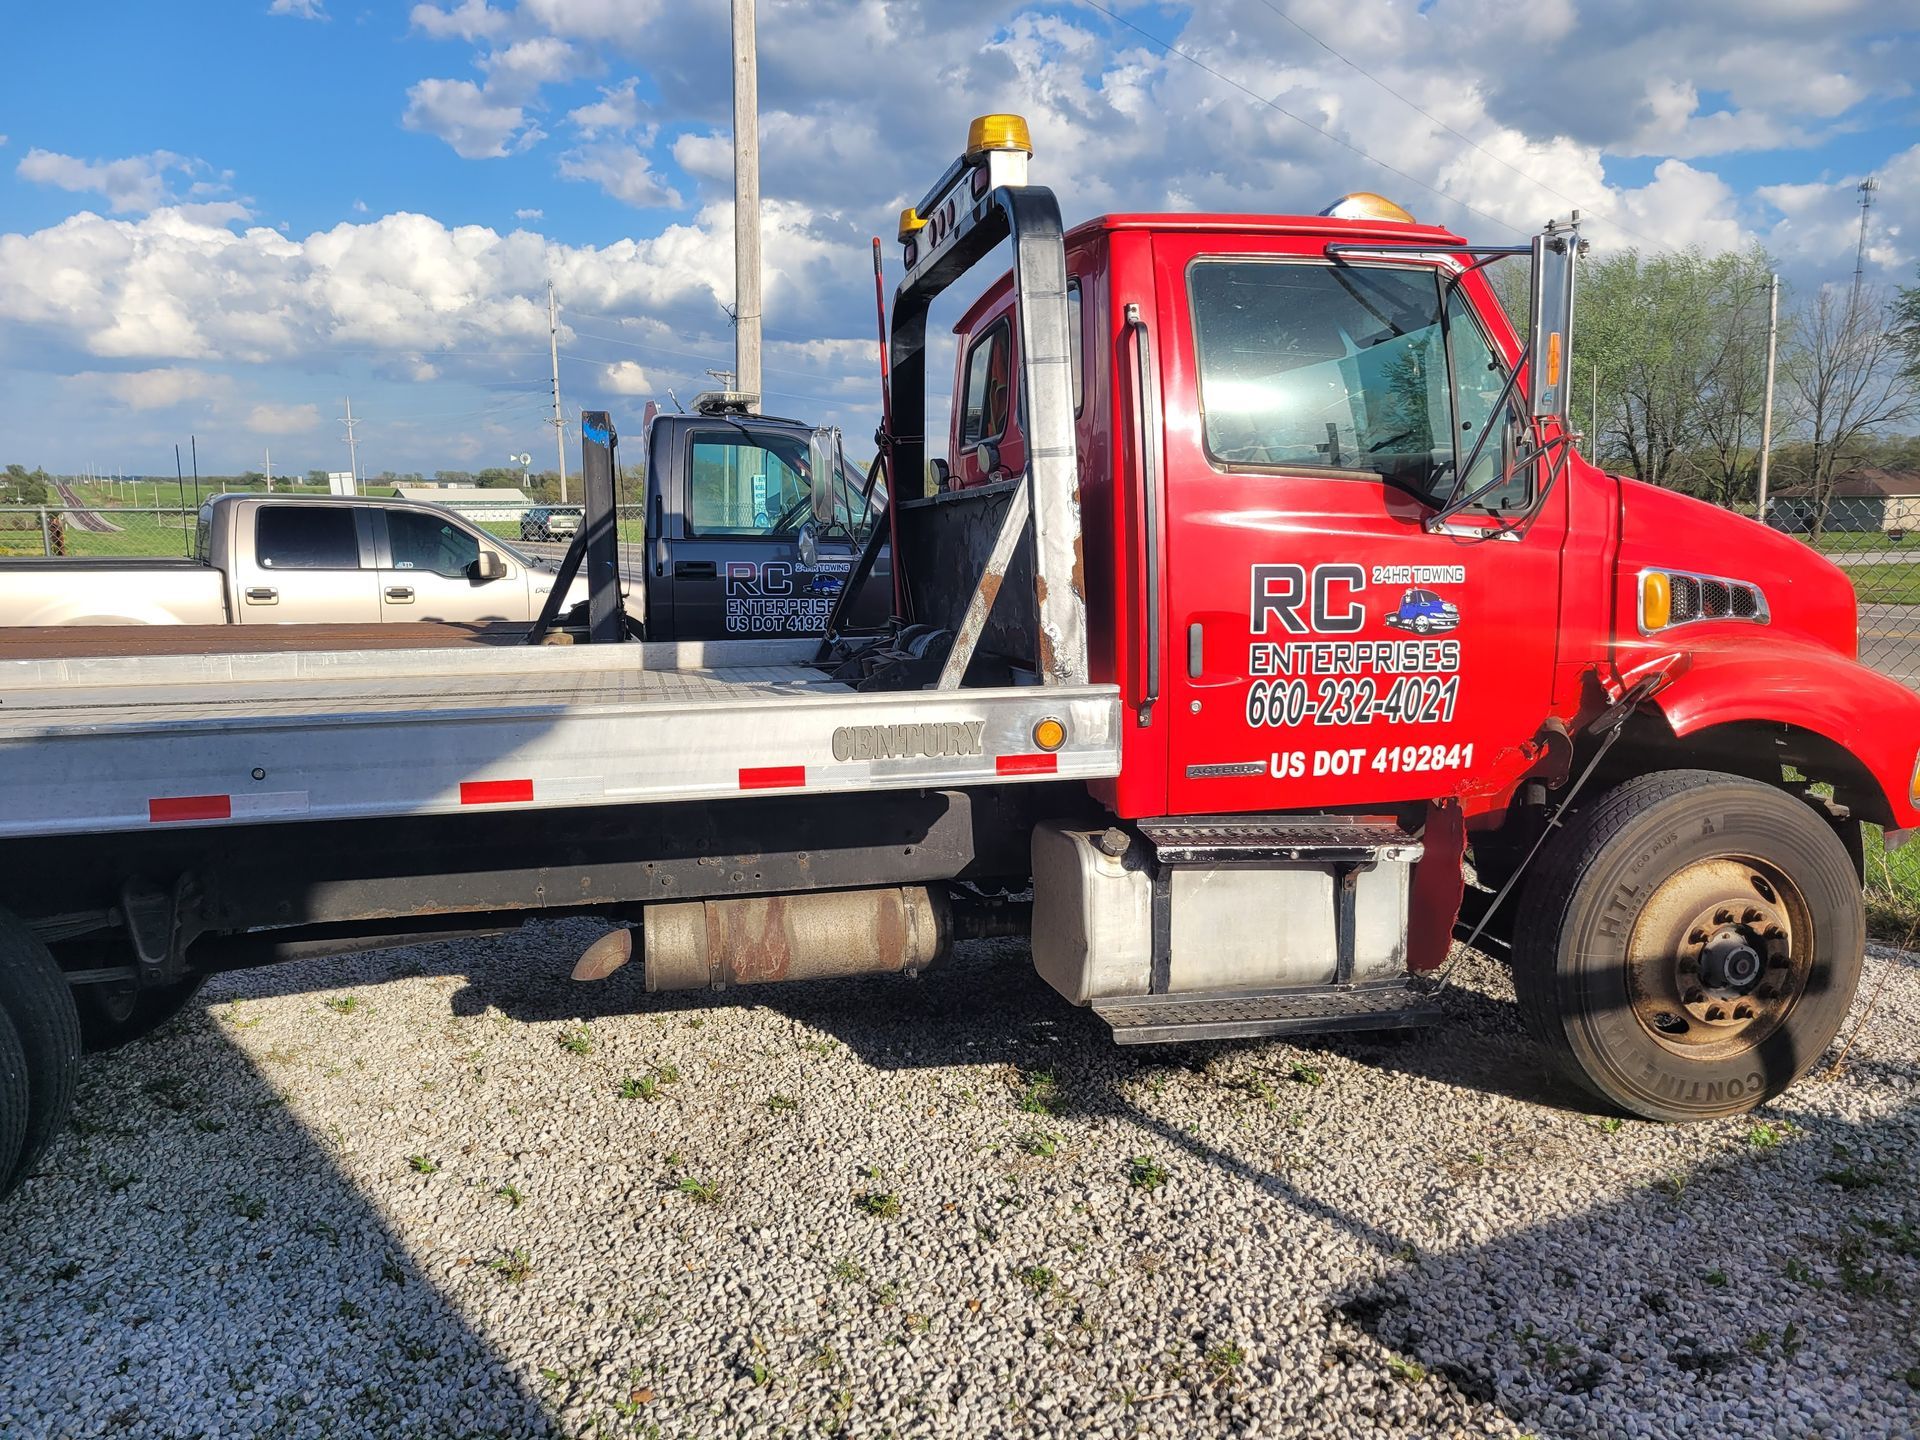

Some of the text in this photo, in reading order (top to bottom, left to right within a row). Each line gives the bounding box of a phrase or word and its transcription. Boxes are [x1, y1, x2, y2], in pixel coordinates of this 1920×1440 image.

[726, 562, 793, 595] RC
[819, 562, 850, 572] TOWING
[1372, 565, 1465, 584] 24HR TOWING
[726, 599, 837, 615] ENTERPRISE
[1250, 564, 1366, 634] RC
[726, 616, 830, 631] US DOT 41928
[1250, 640, 1460, 675] ENTERPRISES
[1246, 676, 1460, 727] 660-232-4021
[832, 720, 985, 762] CENTURY
[1270, 743, 1474, 779] US DOT 4192841
[1600, 832, 1679, 938] HTL ECO PLUS
